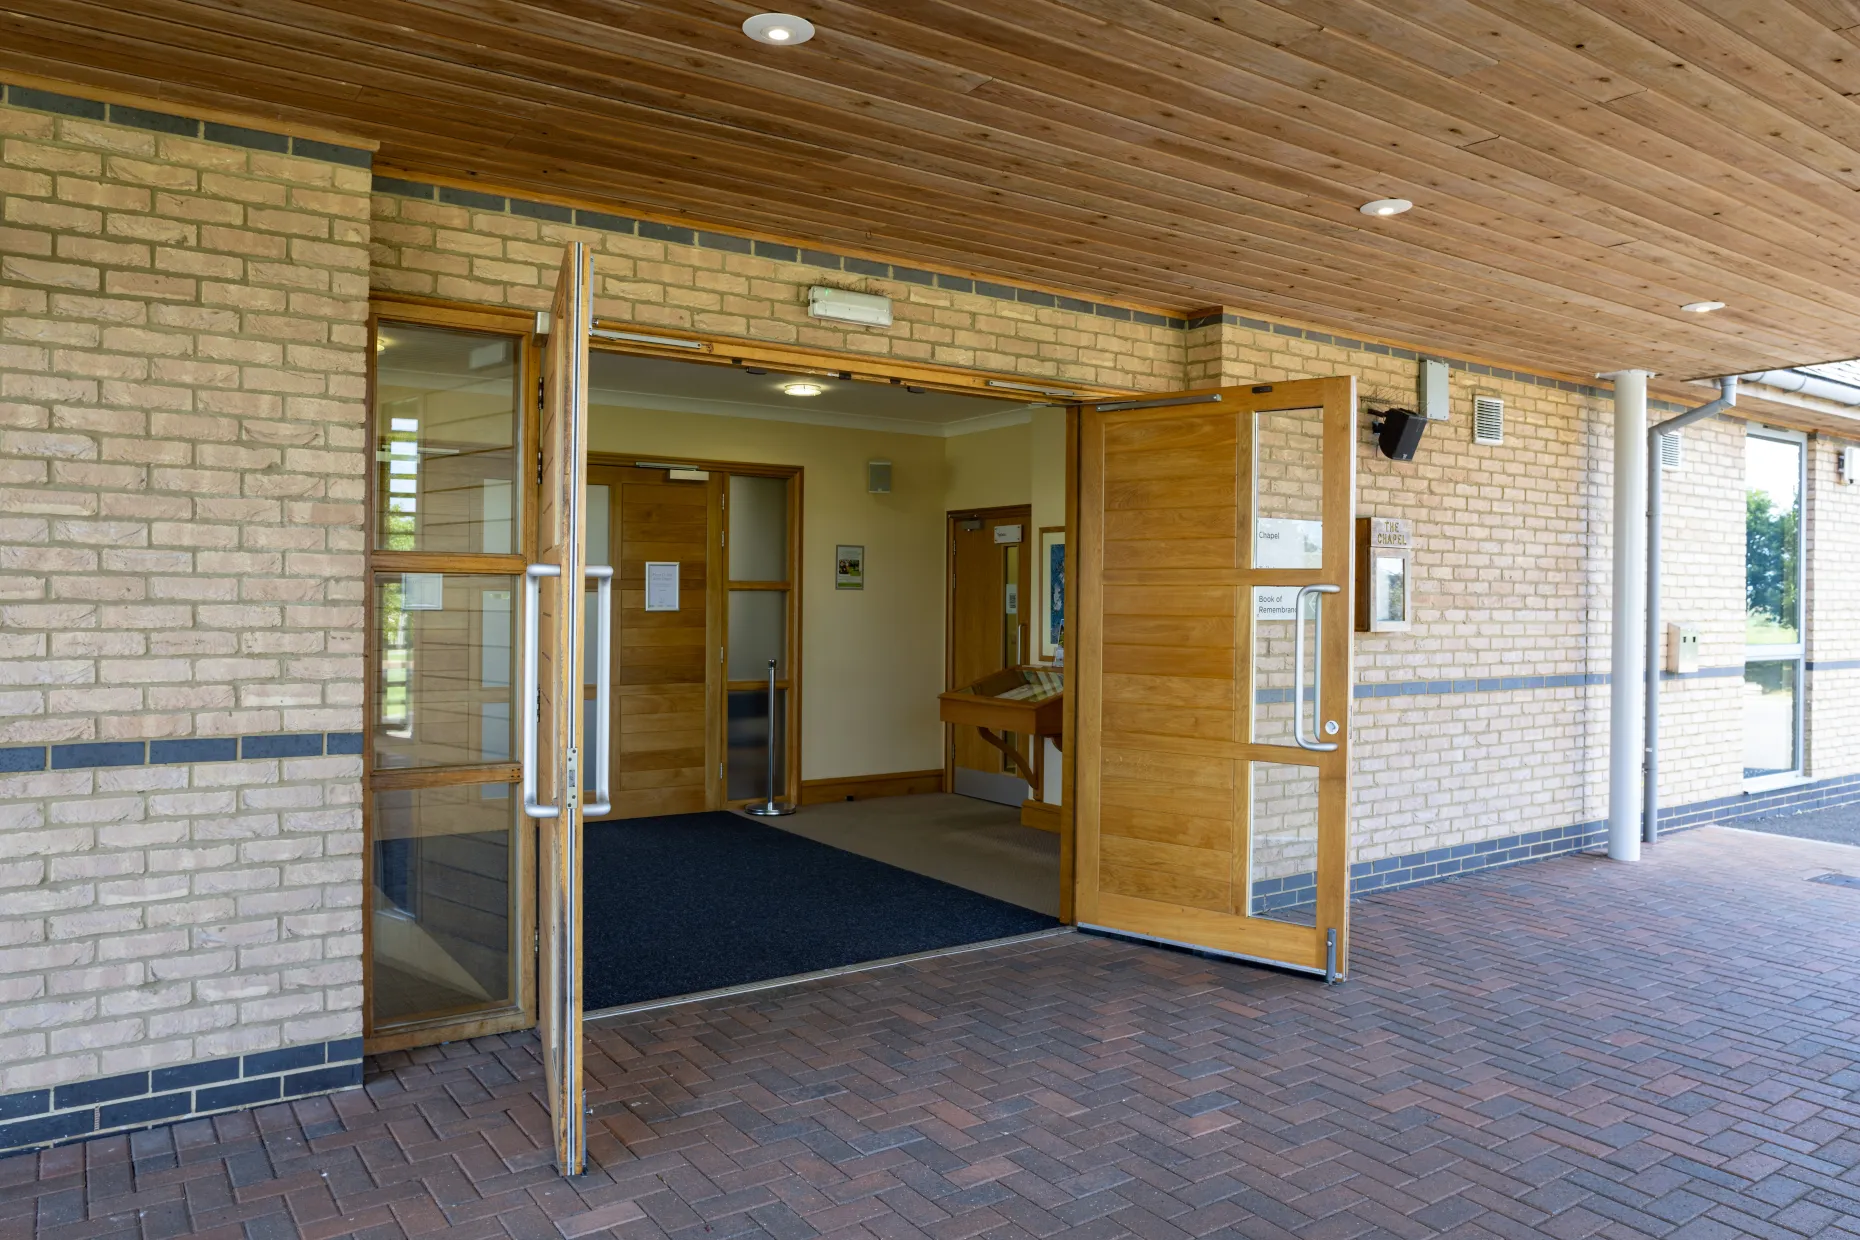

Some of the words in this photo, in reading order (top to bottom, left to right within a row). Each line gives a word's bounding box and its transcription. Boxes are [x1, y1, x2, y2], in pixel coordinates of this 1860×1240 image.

[1385, 521, 1399, 532] THE
[1259, 531, 1280, 540] Chapel
[1377, 533, 1407, 545] CHAPEL
[1258, 595, 1275, 603] Book
[1276, 595, 1283, 603] of
